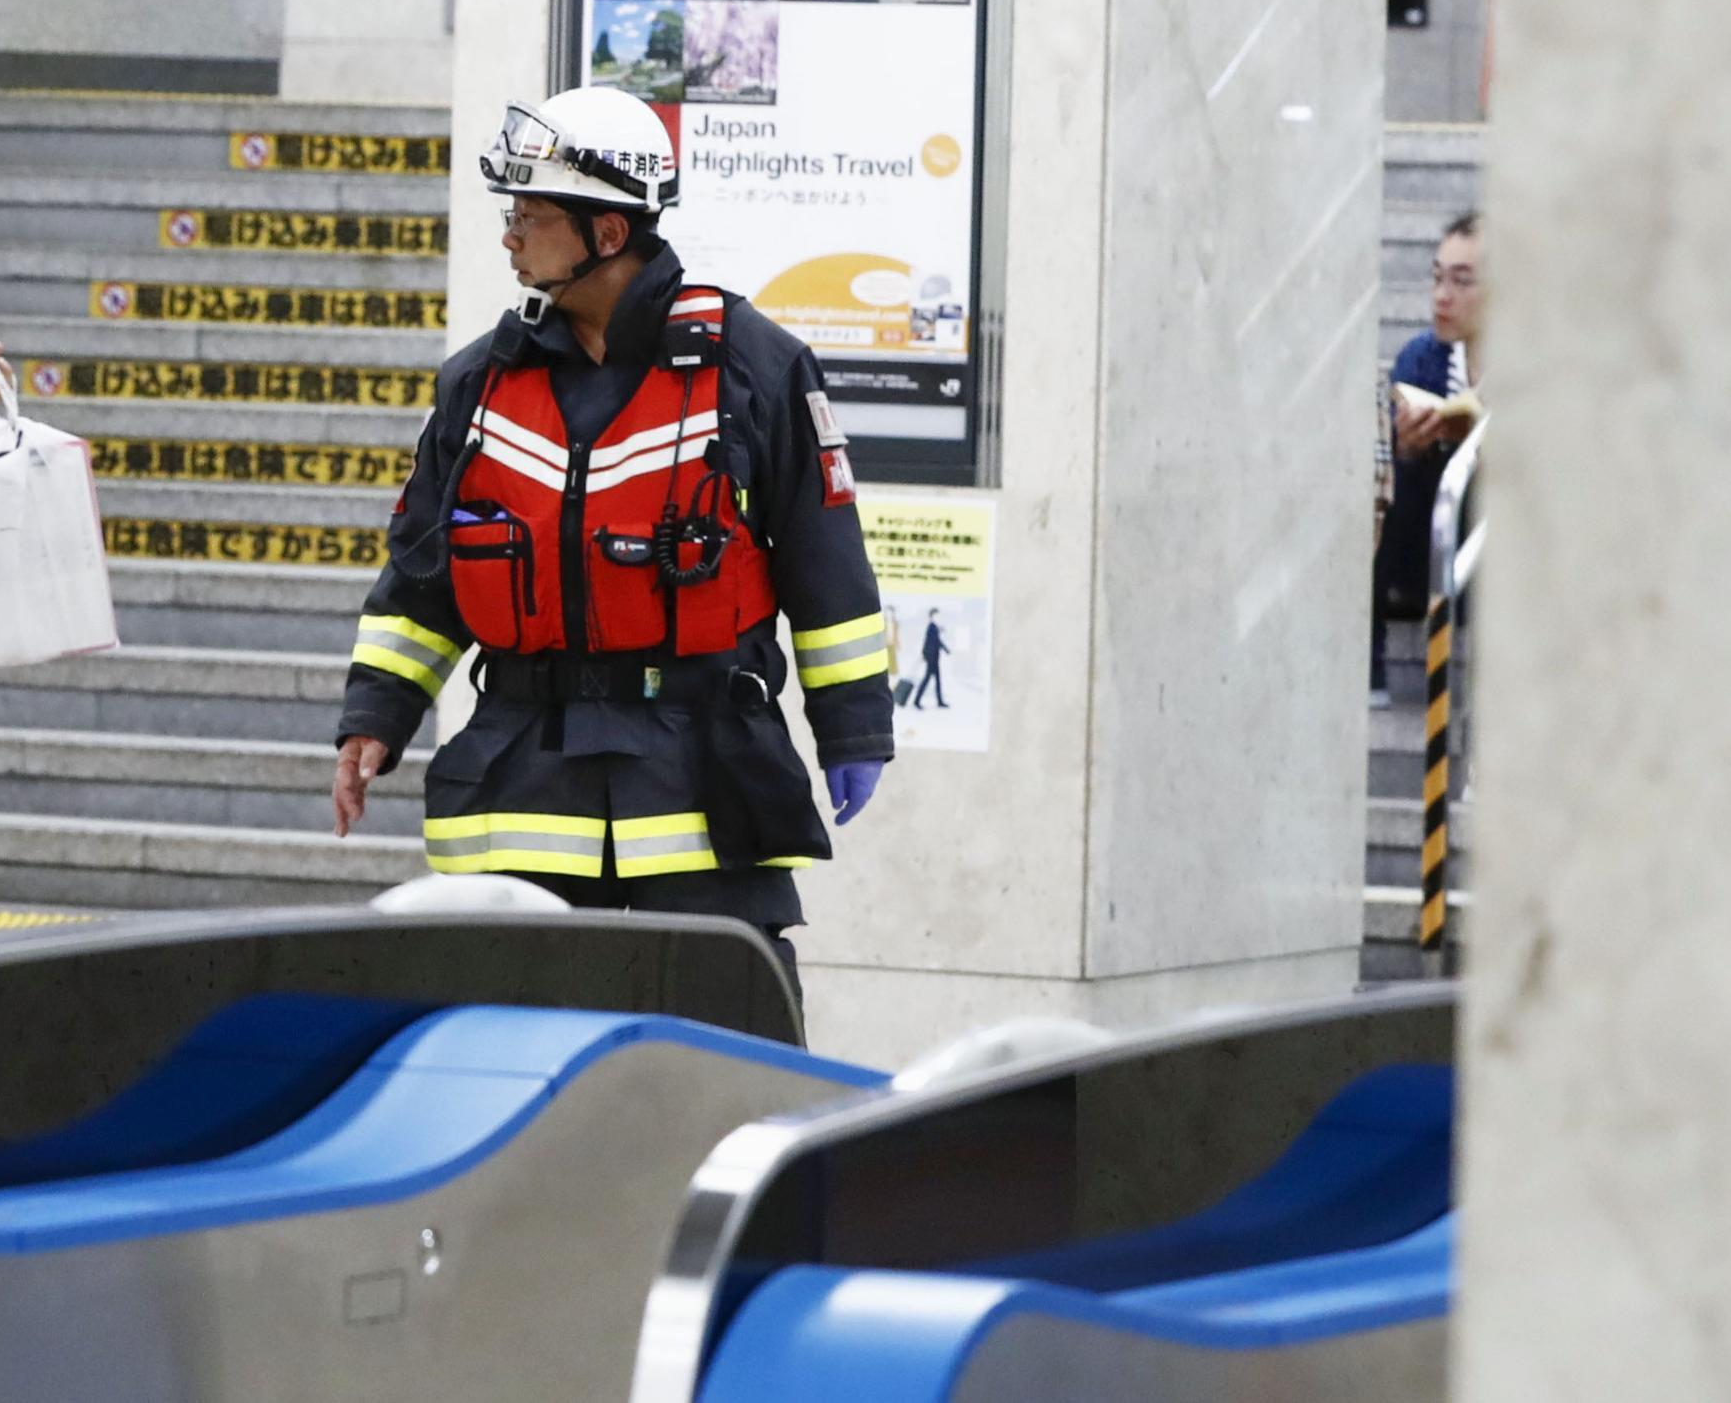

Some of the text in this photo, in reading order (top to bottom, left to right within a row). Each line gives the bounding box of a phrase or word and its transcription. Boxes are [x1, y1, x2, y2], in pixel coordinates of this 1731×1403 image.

[694, 114, 776, 142] Japan
[692, 150, 913, 180] Highlights Travel
